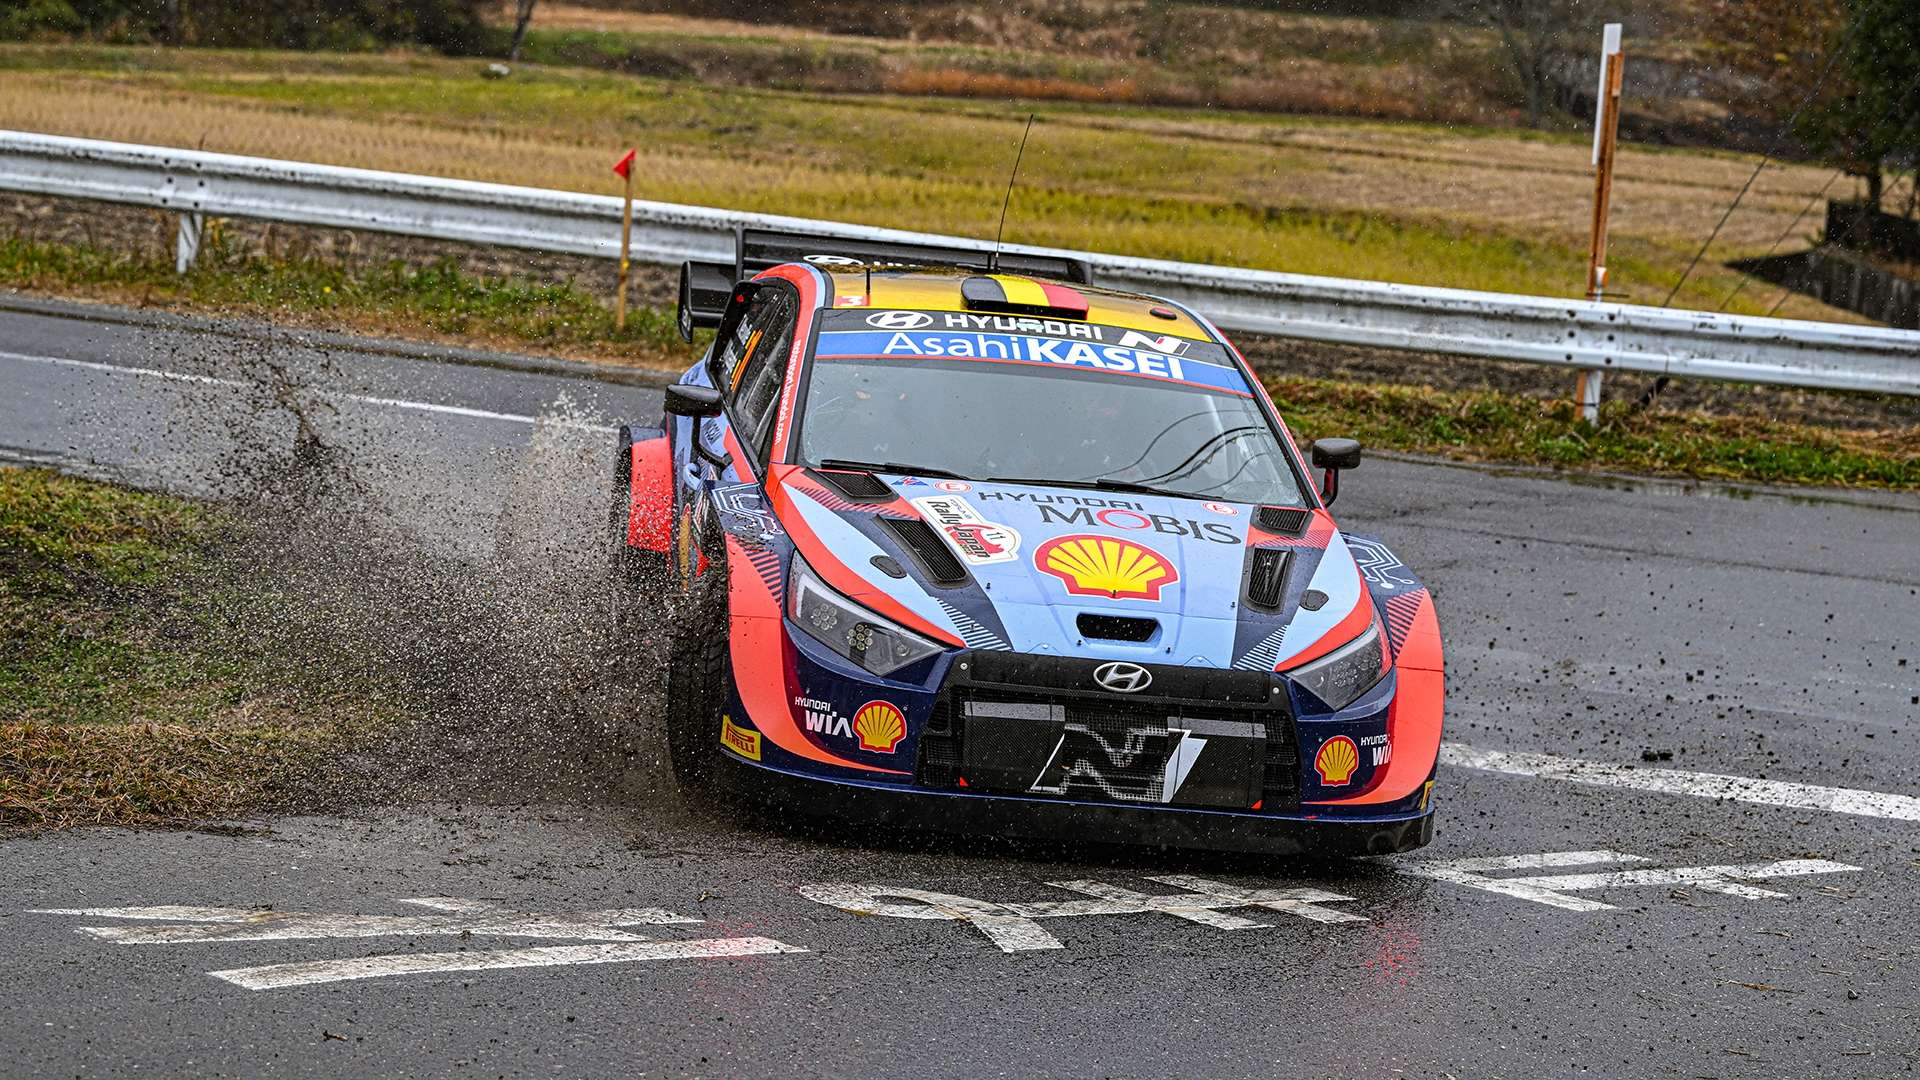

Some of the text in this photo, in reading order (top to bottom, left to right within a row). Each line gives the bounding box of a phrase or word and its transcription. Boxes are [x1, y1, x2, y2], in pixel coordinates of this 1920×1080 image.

[840, 295, 863, 306] 3
[944, 313, 1103, 341] HYUNDAI
[978, 491, 1144, 512] HYUNDAI
[926, 500, 962, 527] Rally
[953, 525, 991, 559] Japan
[1037, 504, 1242, 545] MOBIS
[794, 696, 831, 712] HYUNDAI
[725, 721, 756, 754] PIRELLI
